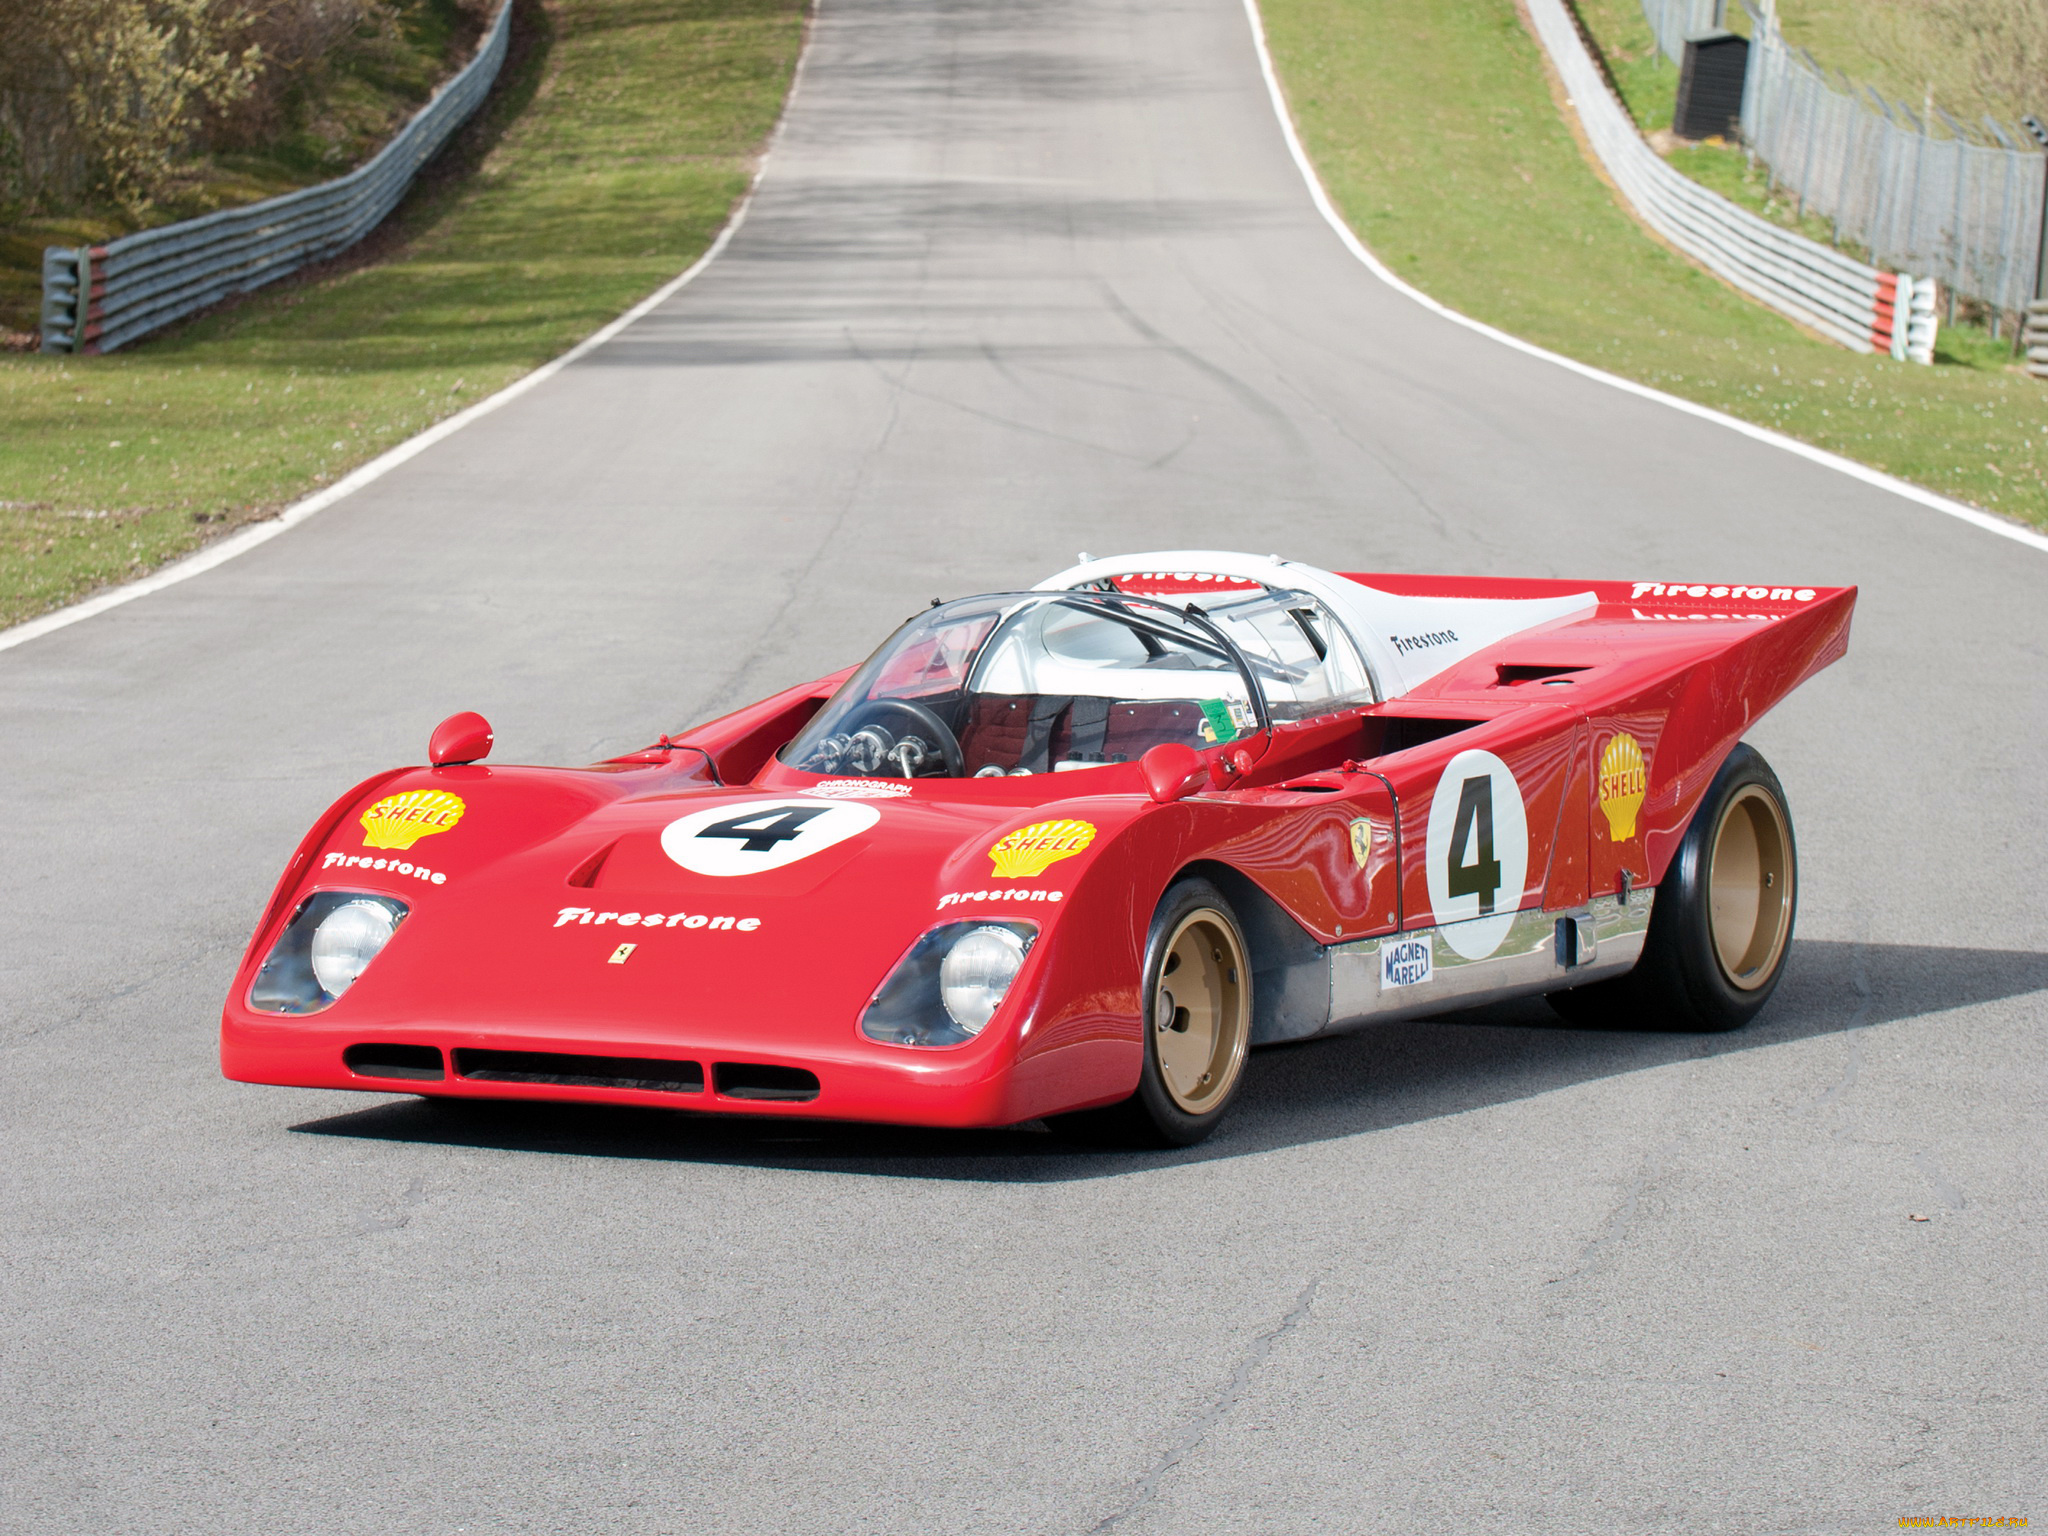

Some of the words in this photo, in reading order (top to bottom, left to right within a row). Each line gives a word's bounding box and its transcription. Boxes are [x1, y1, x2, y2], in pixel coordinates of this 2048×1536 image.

[1631, 582, 1816, 601] Firestone
[1390, 629, 1459, 657] Firestone
[816, 779, 913, 793] CHRONOGRAPH
[1601, 769, 1643, 801] SHELL
[369, 805, 450, 827] SHELL
[694, 805, 836, 852] 4
[998, 836, 1082, 852] SHELL
[1448, 774, 1501, 915] 4
[322, 852, 447, 885] Firestone
[936, 888, 1064, 911] Firestone
[553, 907, 762, 932] Firestone
[1385, 942, 1429, 969] MAGNETI
